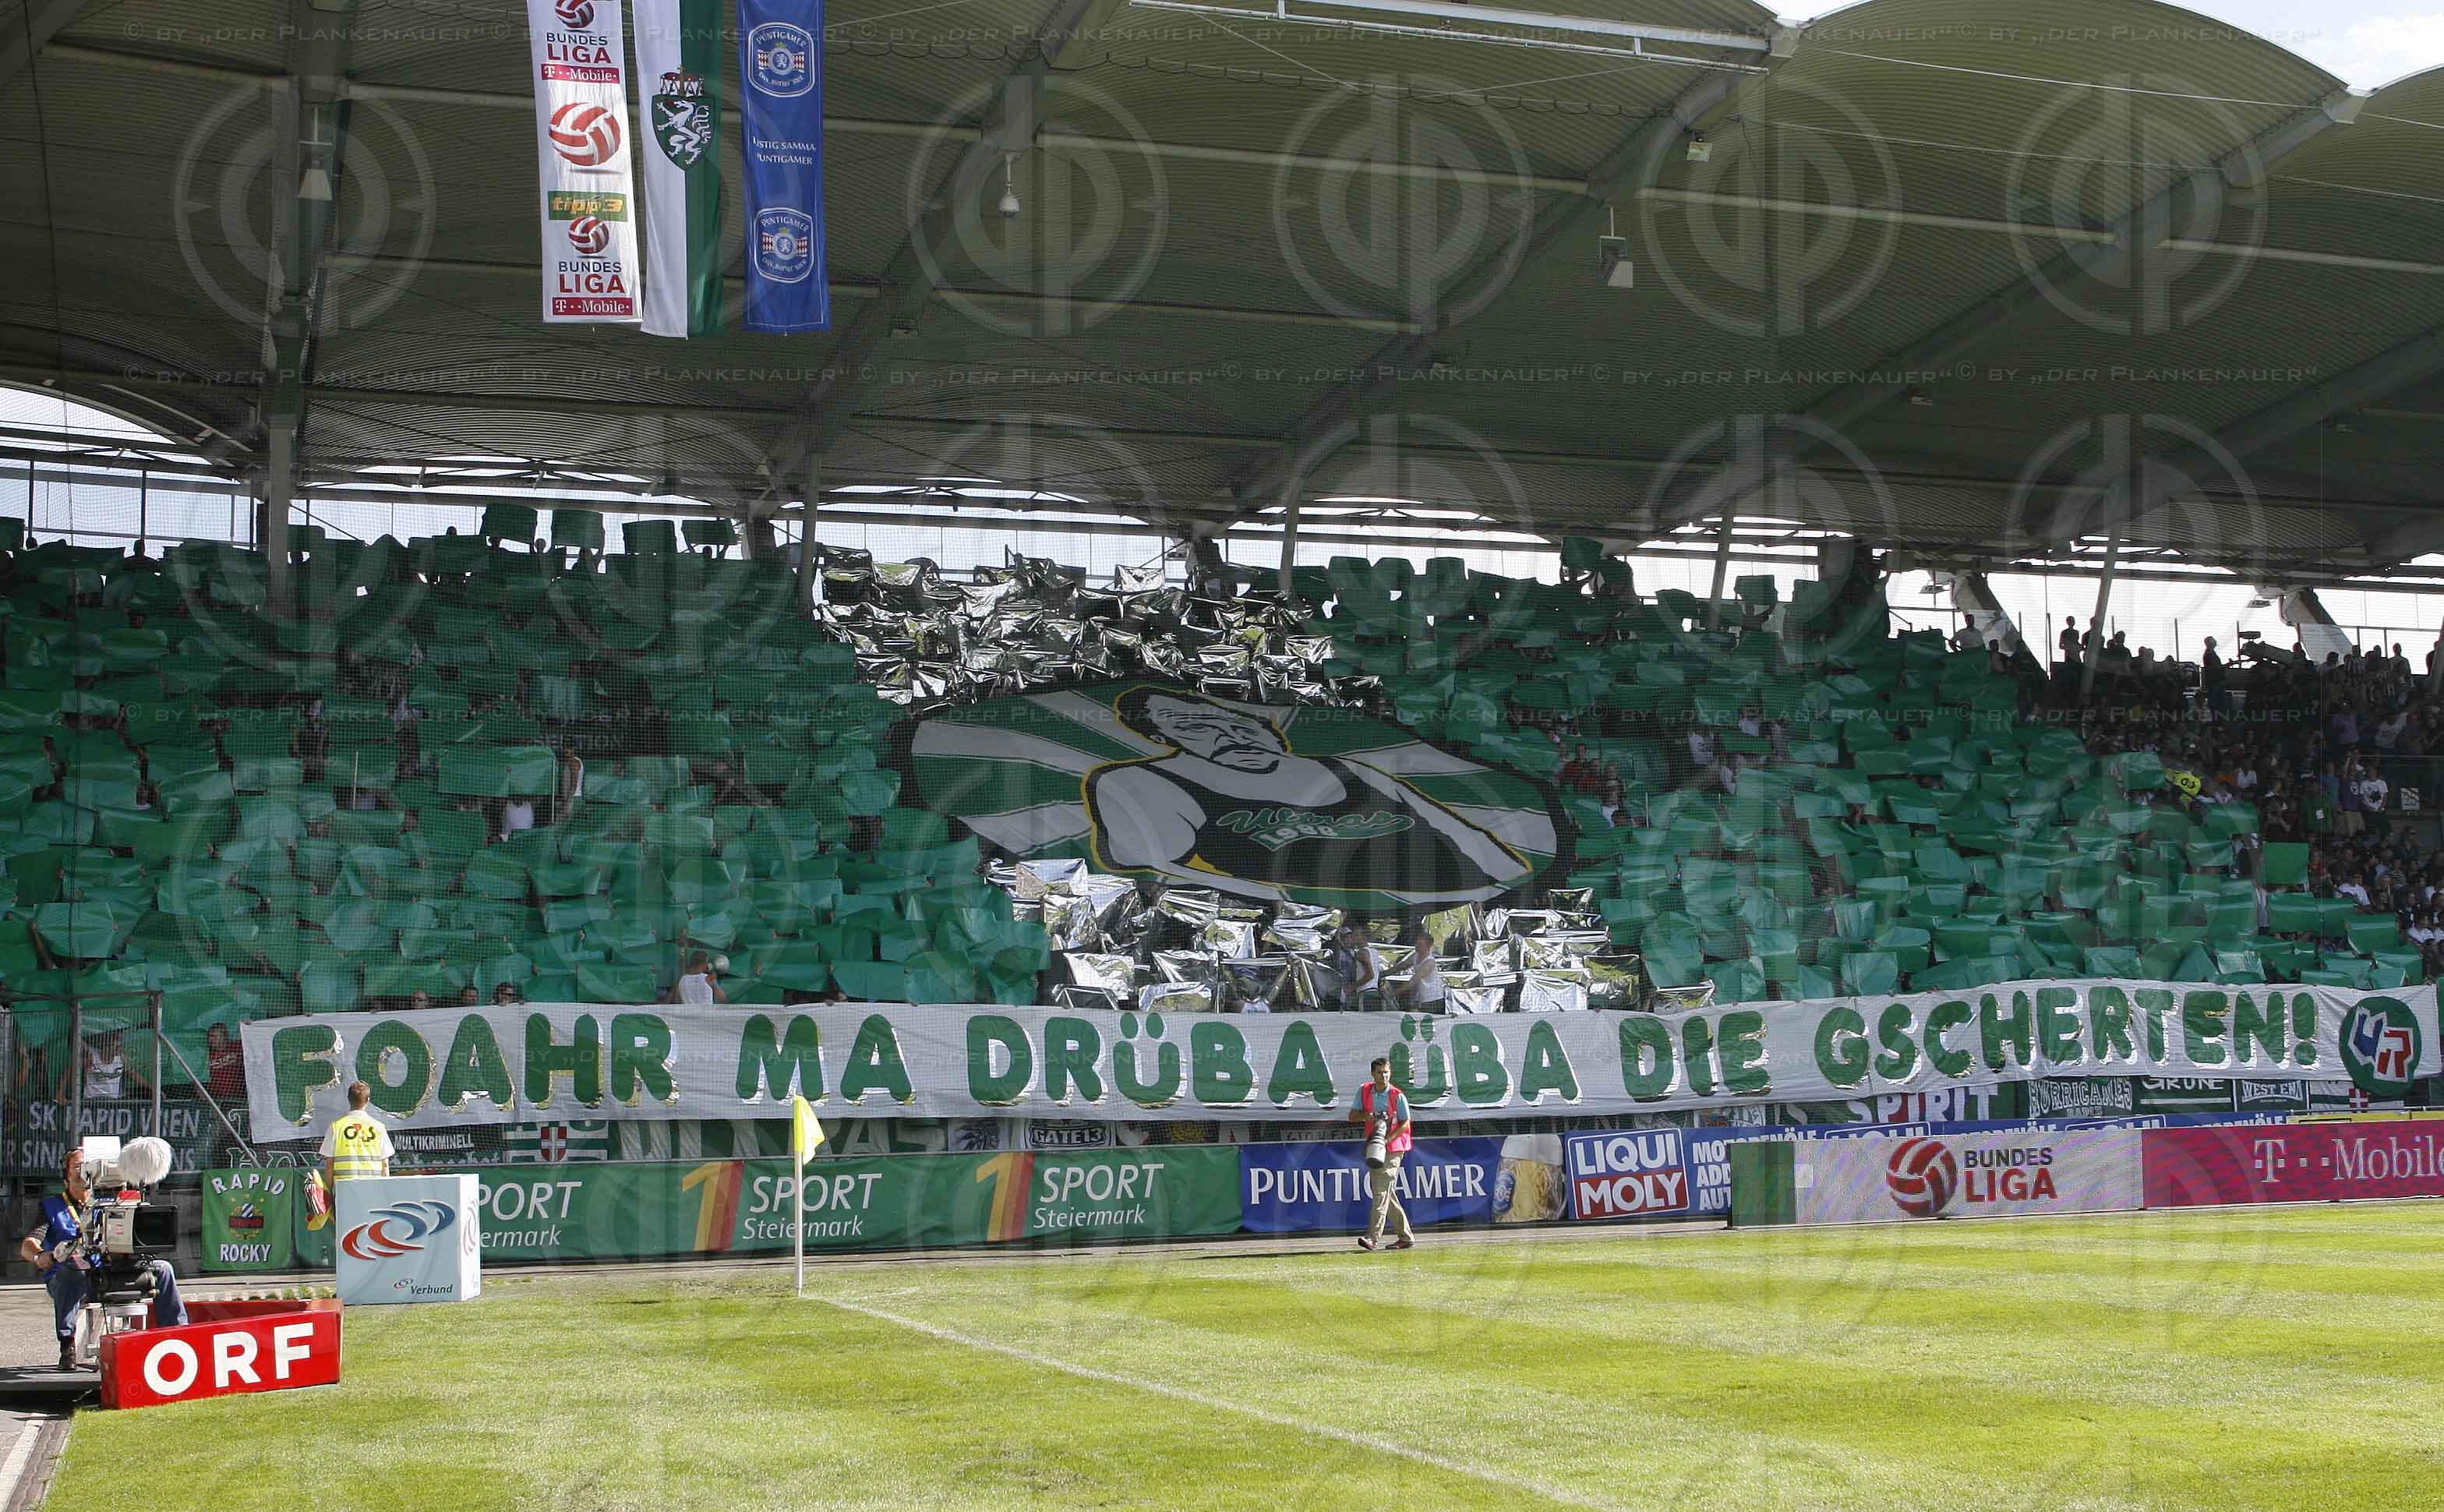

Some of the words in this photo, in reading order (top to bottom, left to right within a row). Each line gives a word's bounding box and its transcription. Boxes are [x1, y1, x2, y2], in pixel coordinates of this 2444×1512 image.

[546, 32, 608, 45] BUNDES
[547, 44, 611, 63] LIGA
[559, 261, 622, 273] BUNDES
[560, 274, 625, 294] LIGA
[272, 1013, 680, 1127] FOAHR
[735, 1014, 917, 1107] MA
[966, 1012, 1339, 1109] DRÜBA
[1389, 1013, 1584, 1109] ÜBA
[1619, 1010, 1773, 1102] DIE
[1814, 986, 2321, 1090] GSCHERTEN!
[2242, 1080, 2276, 1100] WEST
[1575, 1133, 1678, 1176] LIQUI
[1964, 1148, 2054, 1168] BUNDES
[212, 1173, 285, 1195] RAPID
[750, 1173, 883, 1213] SPORT
[1040, 1164, 1164, 1203] SPORT
[1580, 1171, 1683, 1216] MOLY
[1965, 1168, 2060, 1203] LIGA
[479, 1181, 583, 1221] PORT
[743, 1215, 863, 1241] Steiermark
[1033, 1204, 1146, 1229] Steiermark
[220, 1243, 271, 1262] ROCKY
[411, 1284, 453, 1295] Verbund
[143, 1322, 314, 1396] ORF
